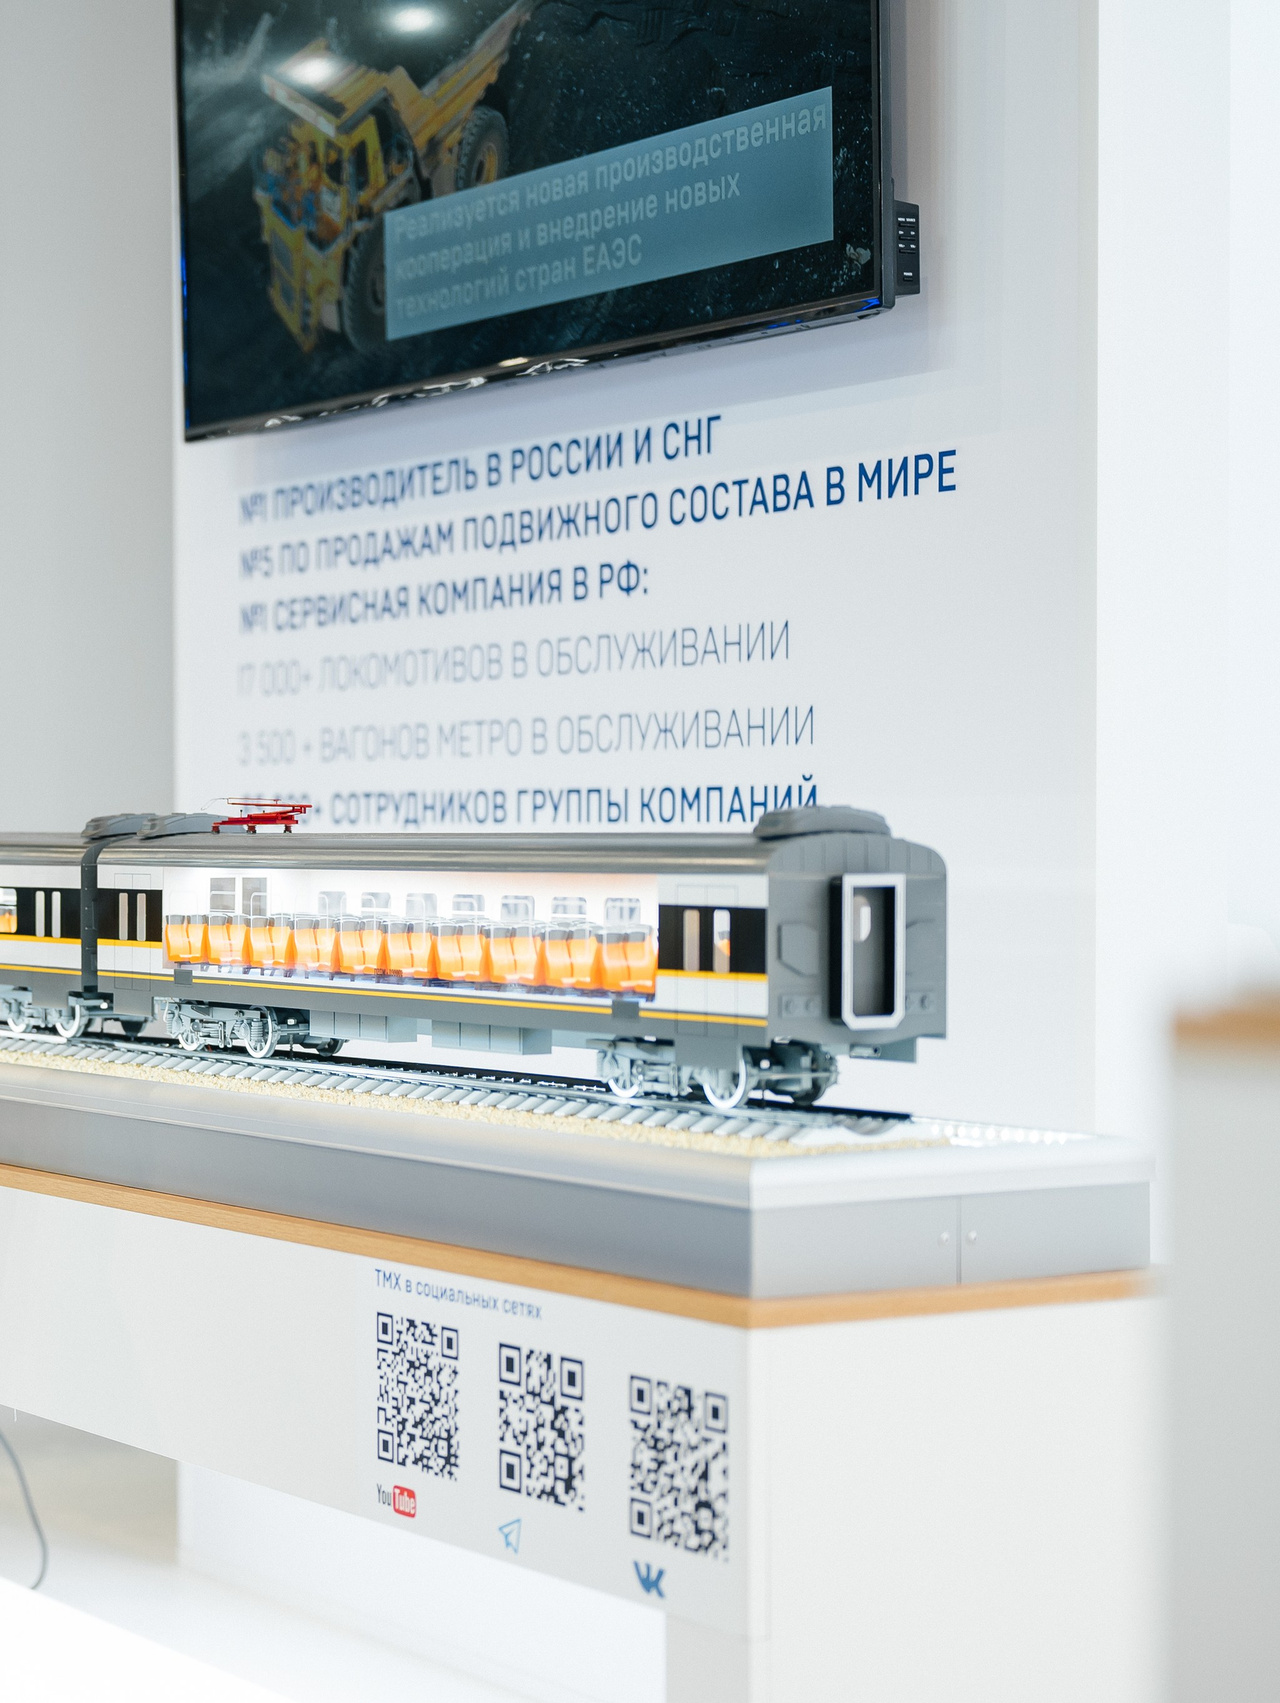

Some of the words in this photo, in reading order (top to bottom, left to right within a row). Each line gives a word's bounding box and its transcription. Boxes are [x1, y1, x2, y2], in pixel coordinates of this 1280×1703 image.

[393, 189, 520, 243] Реализуется
[524, 169, 588, 209] новая
[595, 103, 827, 192] производственная
[395, 231, 512, 282] кооперация
[518, 227, 531, 250] и
[536, 193, 658, 246] внедрение
[665, 172, 741, 214] новых
[396, 266, 510, 318] технологий
[514, 256, 577, 293] стран
[581, 233, 642, 276] ЕАЭС
[273, 456, 478, 521] ПРОИЗВОДИТЕЛЬ
[487, 452, 502, 488] В
[511, 431, 623, 483] РОССИИ
[634, 426, 652, 466] И
[663, 414, 722, 461] СНГ
[278, 541, 310, 575] ПО
[315, 521, 455, 569] ПРОДАЖАМ
[463, 491, 658, 554] ПОДВИЖНОГО
[669, 470, 815, 526] СОСТАВА
[826, 465, 846, 506] В
[858, 449, 957, 503] МИРЕ
[274, 585, 410, 632] СЕРВИСНАЯ
[418, 568, 562, 616] КОМПАНИЯ
[573, 565, 588, 601] В
[599, 559, 649, 599] РФ:
[319, 642, 503, 692] ЛОКОМОТИВОВ
[512, 640, 528, 679] В
[536, 619, 789, 677] ОБСЛУЖИВАНИИ
[320, 722, 430, 762] ВАГОНОВ
[437, 717, 522, 758] МЕТРО
[532, 717, 548, 755] В
[557, 704, 814, 755] ОБСЛУЖИВАНИИ
[330, 789, 507, 829] СОТРУДНИКОВ
[517, 787, 629, 824] ГРУППЫ
[640, 774, 817, 824] КОМПАНИЙ
[375, 1268, 402, 1291] ТМХ
[405, 1279, 413, 1293] в
[416, 1281, 499, 1311] социальных
[503, 1298, 542, 1320] сетях
[376, 1483, 417, 1517] YouTube
